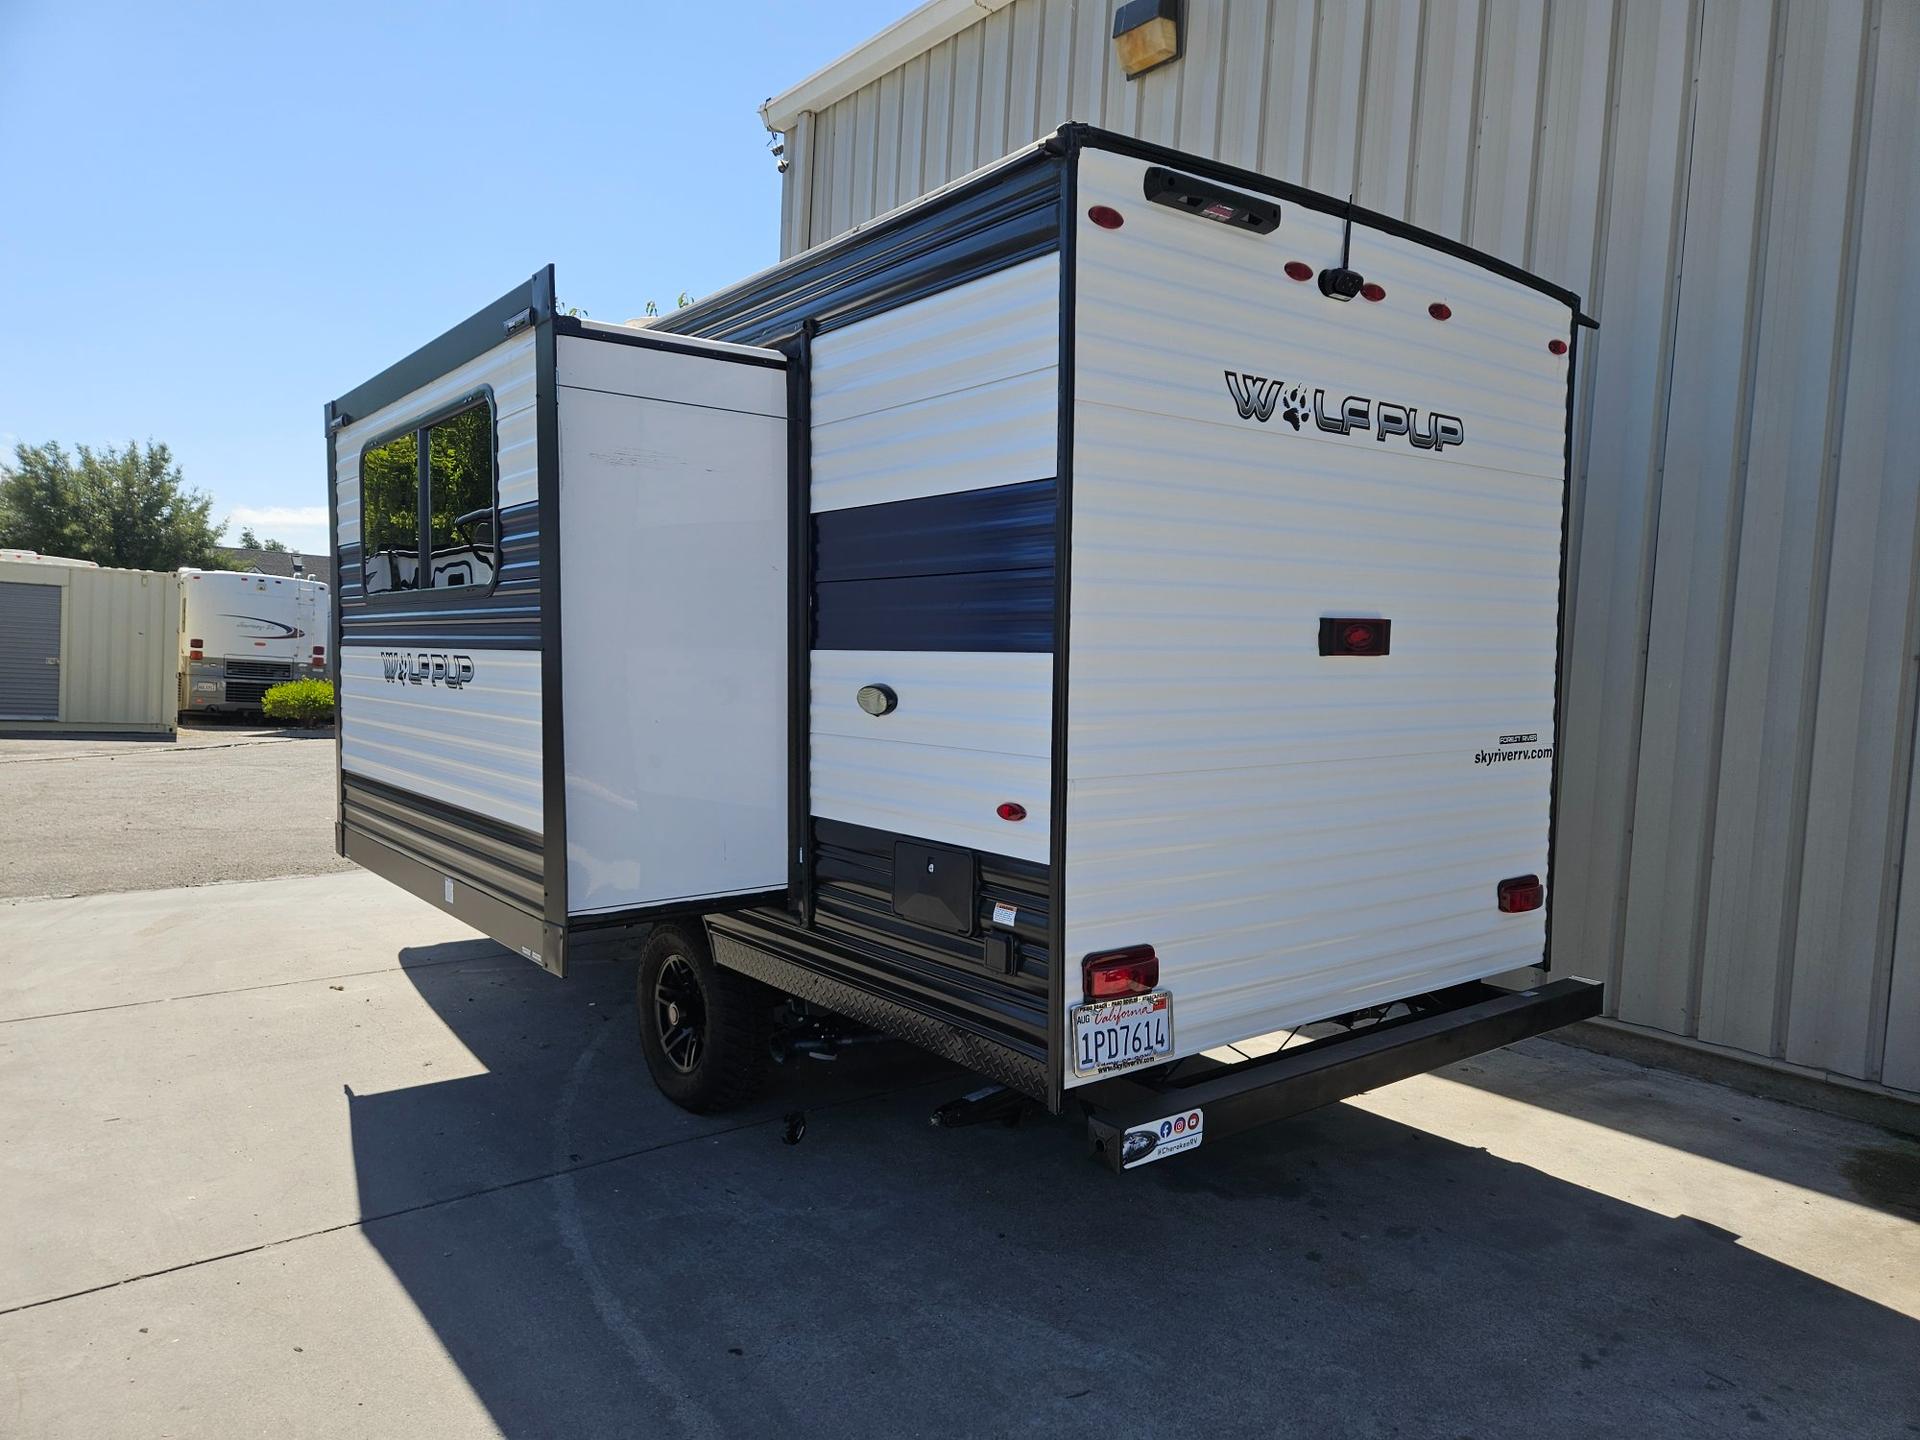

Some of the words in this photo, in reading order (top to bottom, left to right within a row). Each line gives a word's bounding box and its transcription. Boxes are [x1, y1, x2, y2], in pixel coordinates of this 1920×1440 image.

[1376, 401, 1465, 452] PUP
[430, 653, 475, 690] PUP
[1474, 747, 1553, 767] skyriverrv.com
[1077, 1014, 1090, 1025] AUG
[1094, 1005, 1154, 1026] California
[1081, 1018, 1166, 1066] 1PD7614
